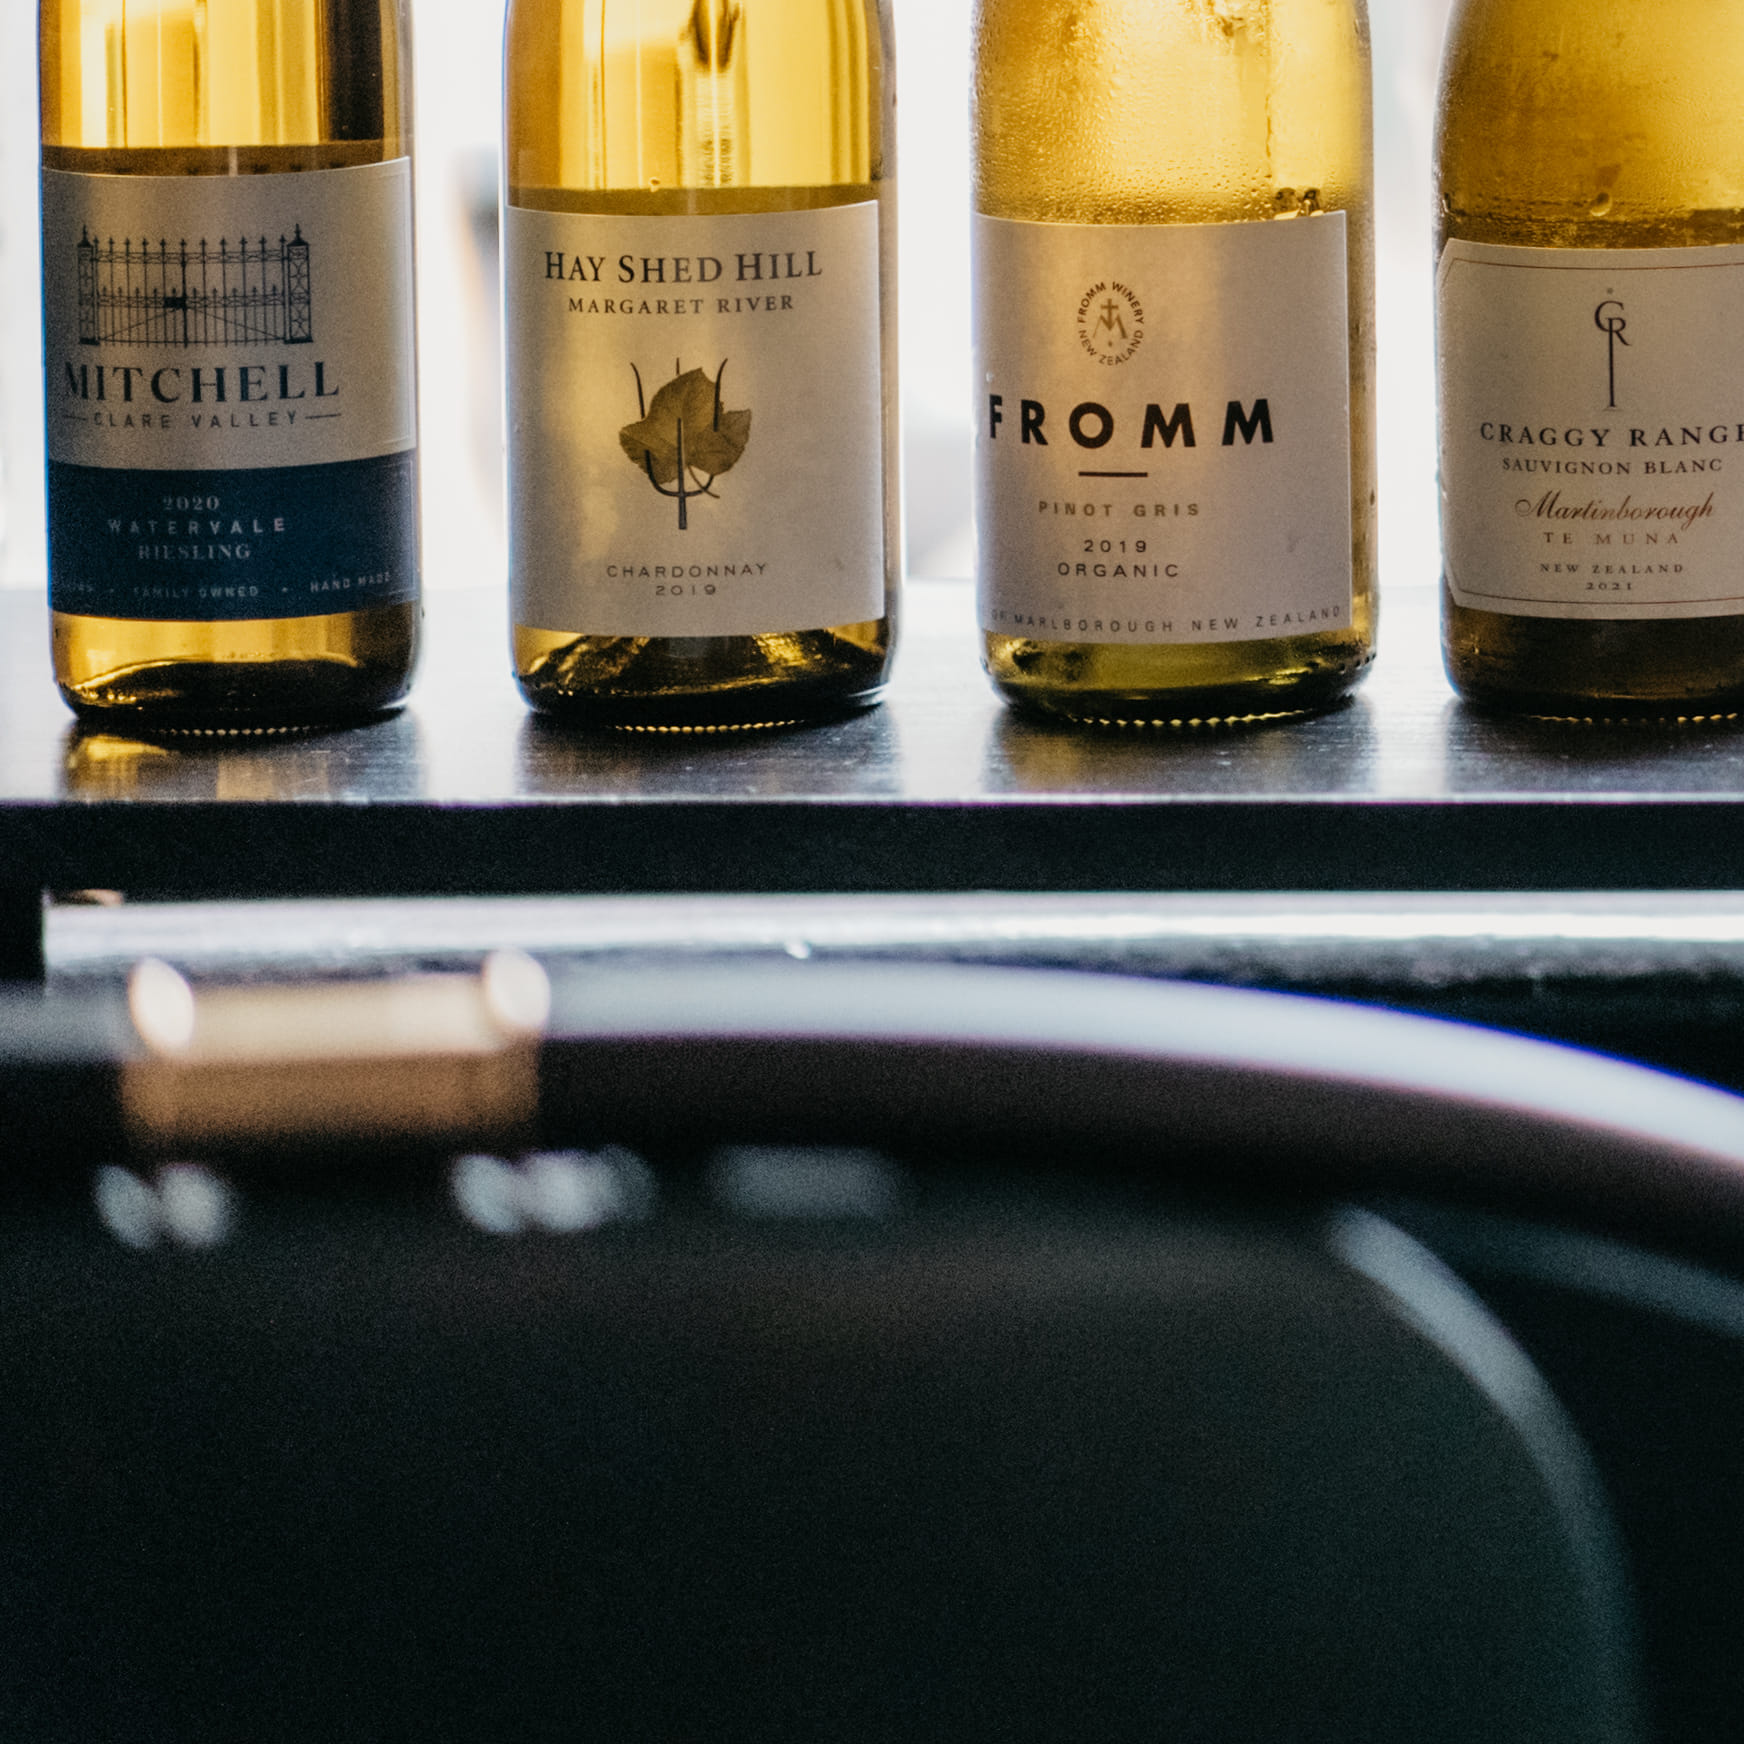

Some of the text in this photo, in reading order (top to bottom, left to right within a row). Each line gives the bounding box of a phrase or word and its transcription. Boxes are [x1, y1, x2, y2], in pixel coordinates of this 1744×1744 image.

[544, 251, 823, 284] HAY SHED HILL
[568, 295, 794, 315] MARGARET RIVER
[1077, 281, 1145, 324] FROMM WINERY
[1078, 329, 1145, 366] NEW ZEALAND
[65, 361, 339, 403] MITCHELL
[93, 411, 298, 428] CLARE VALLEY
[989, 394, 1274, 449] FROMM
[1480, 422, 1610, 447] CRAGGY
[1502, 458, 1723, 475] SAUVIGNON BLANC
[163, 495, 220, 511] 2020
[1038, 501, 1199, 517] PINOT GRIS
[1515, 490, 1715, 530] Martinborough
[108, 518, 286, 535] WATERVALE
[1084, 539, 1148, 553] 2019
[1544, 532, 1679, 546] TE MUNA
[138, 544, 251, 560] RIESLING
[606, 563, 768, 579] CHARDONNAY
[1057, 562, 1179, 578] ORGANIC
[1540, 563, 1684, 575] NEW ZEALAND
[655, 585, 717, 596] 2019
[1585, 582, 1633, 591] 2021
[1013, 614, 1173, 633] MARLBOROUGH
[1191, 617, 1239, 631] NEW
[1255, 605, 1341, 628] ZEALAND
